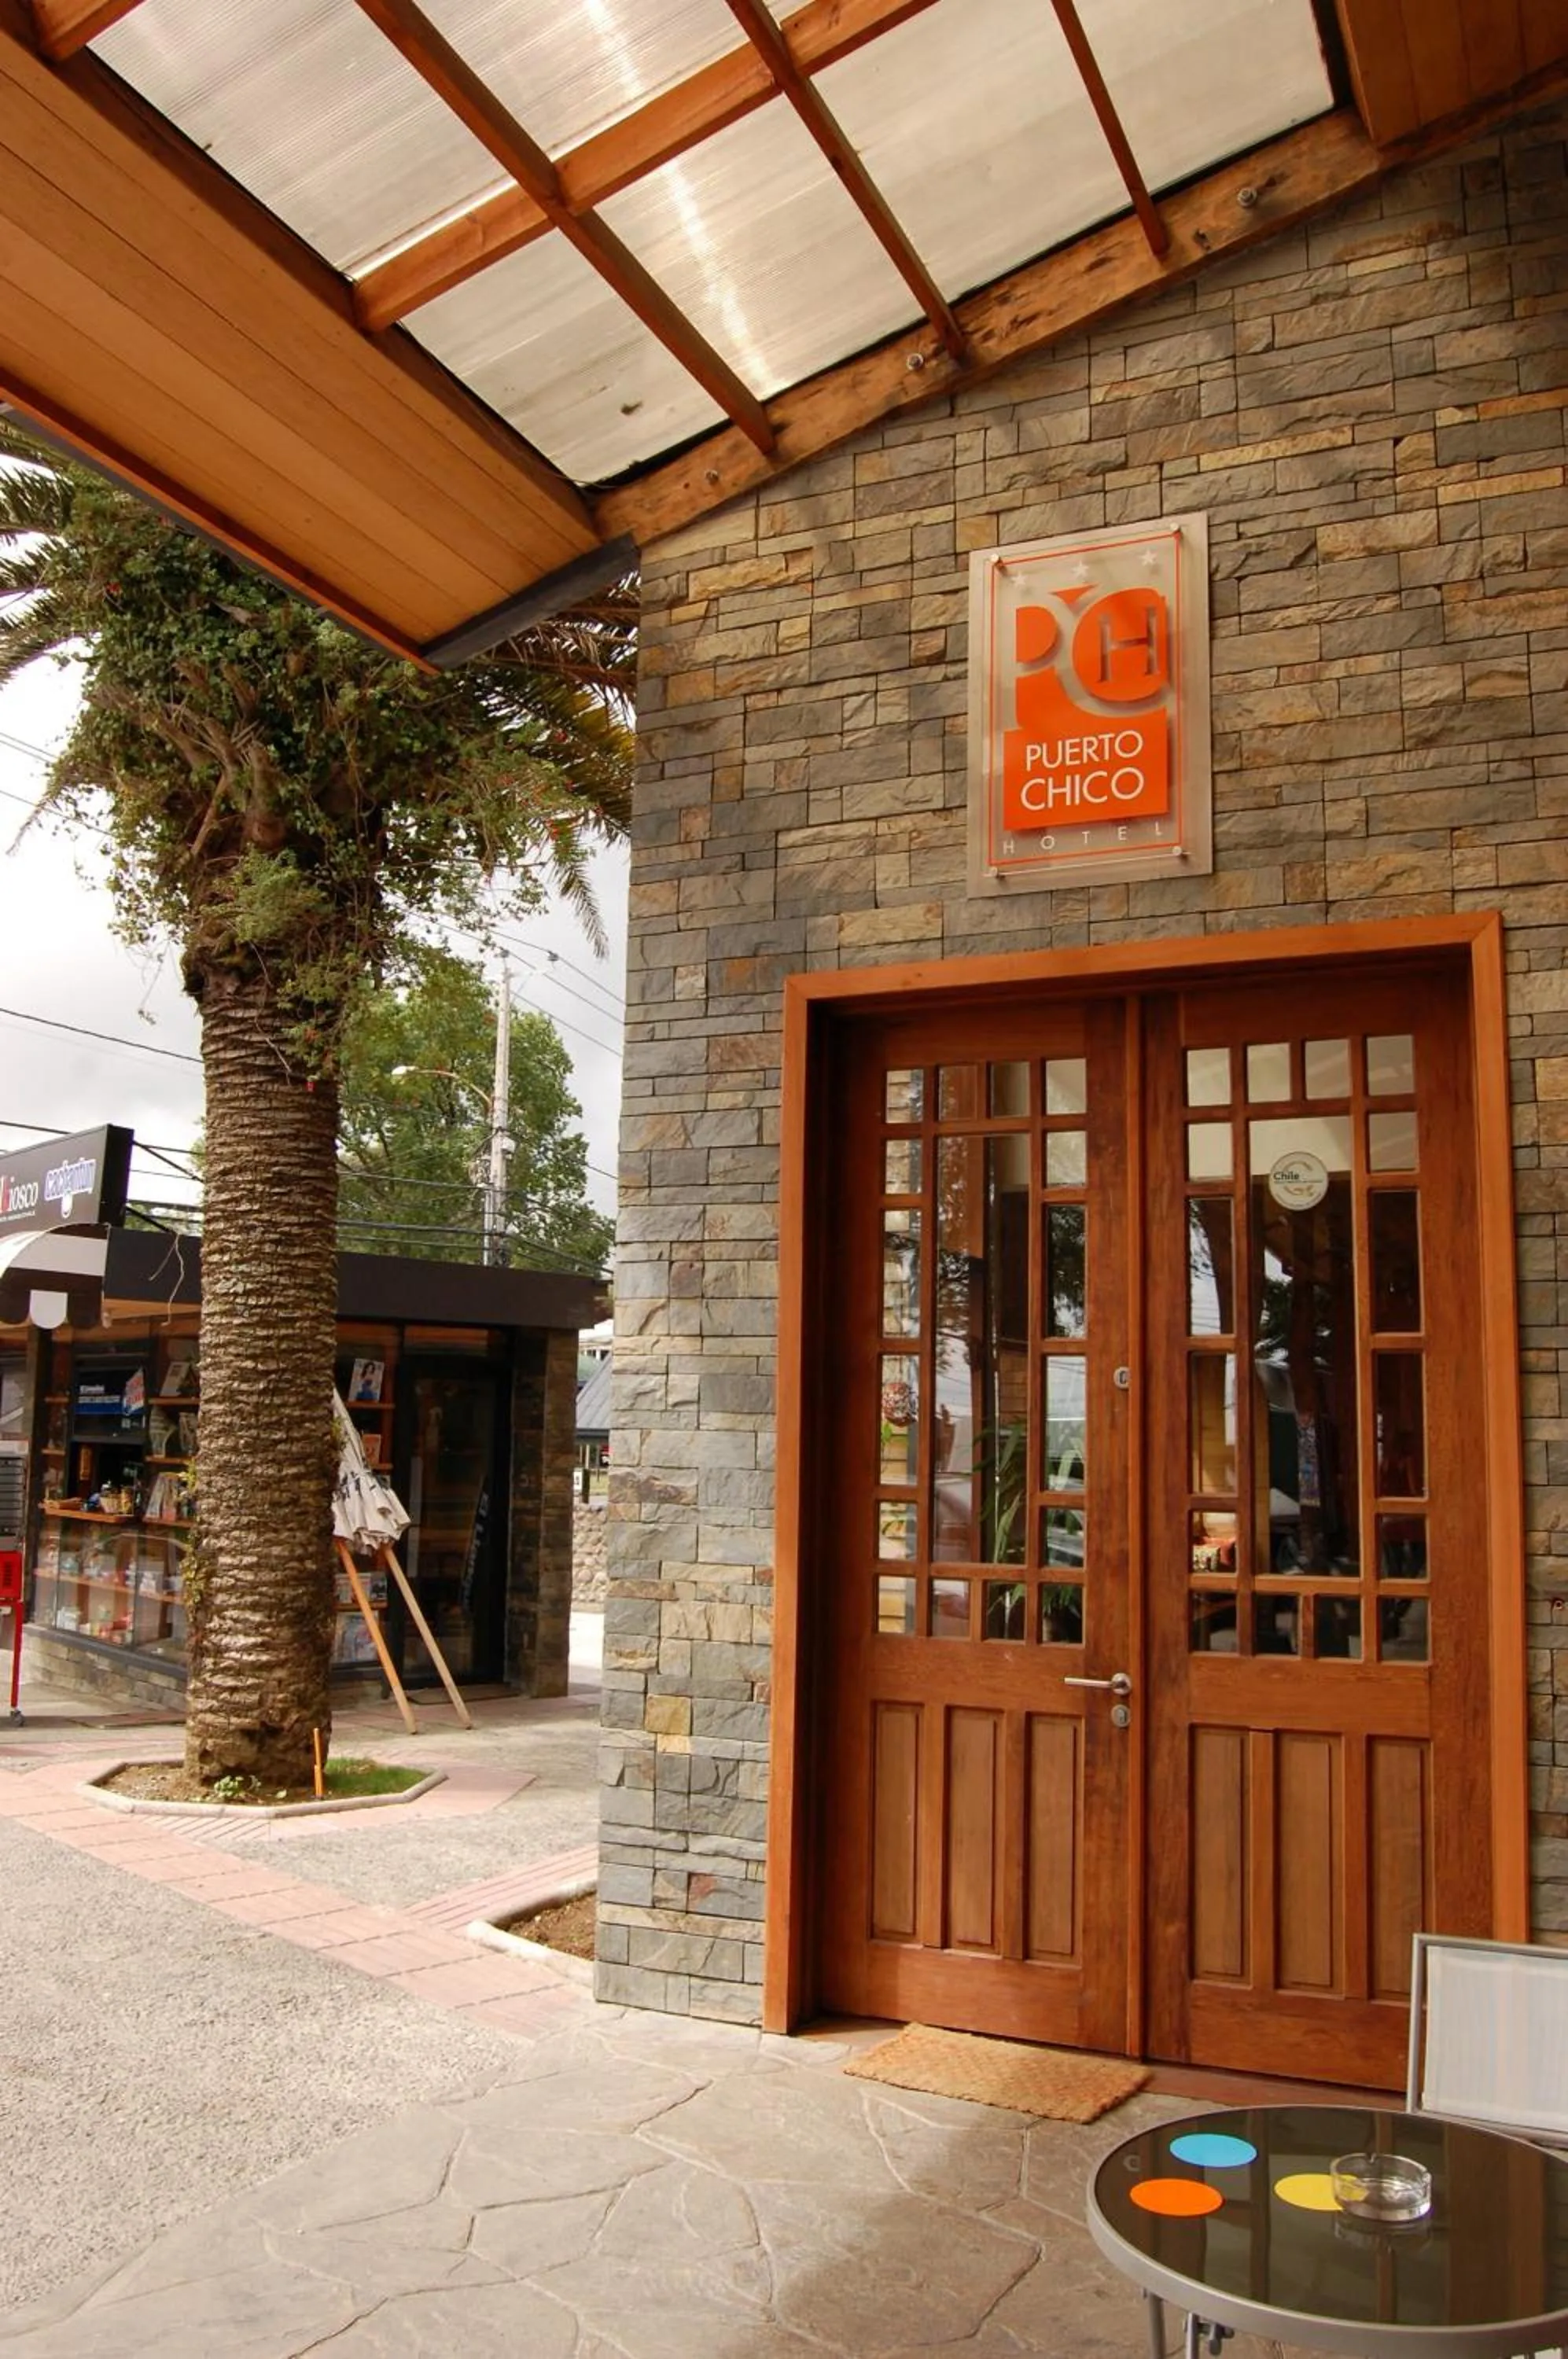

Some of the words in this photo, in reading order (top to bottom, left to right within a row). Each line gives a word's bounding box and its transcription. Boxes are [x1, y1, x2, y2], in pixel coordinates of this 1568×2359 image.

[1026, 730, 1143, 771] PUERTO
[1021, 767, 1144, 811] CHICO
[1003, 822, 1162, 855] HOTEL
[1274, 1171, 1300, 1180] Chile
